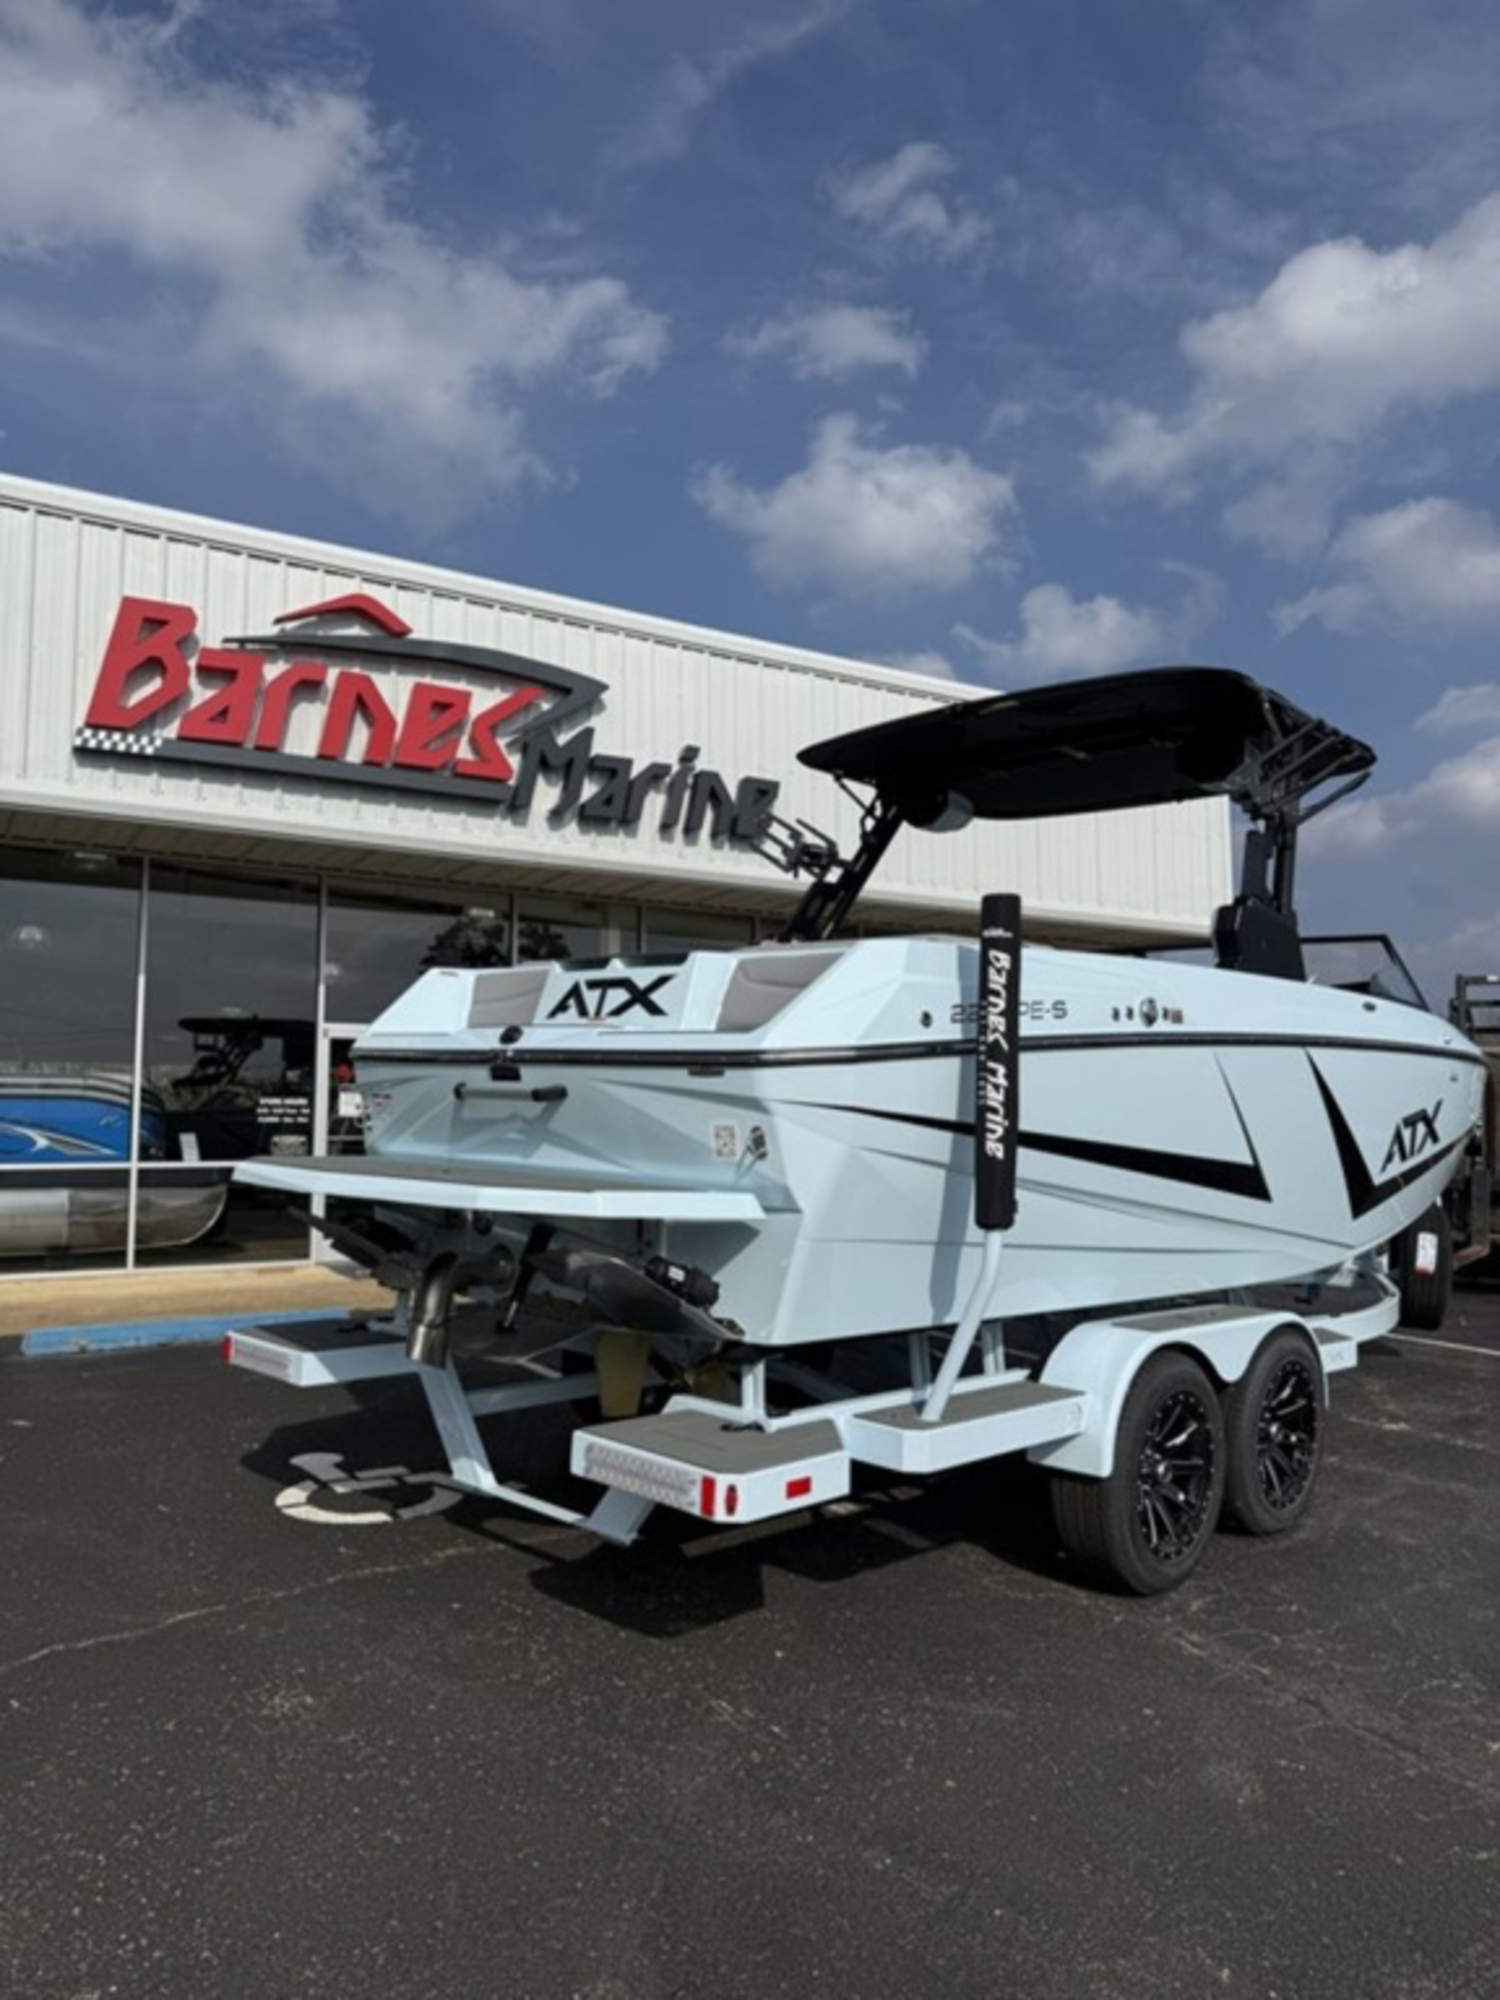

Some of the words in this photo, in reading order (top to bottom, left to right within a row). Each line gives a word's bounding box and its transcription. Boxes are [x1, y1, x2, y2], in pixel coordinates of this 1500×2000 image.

[84, 595, 549, 782] Barnes
[508, 726, 780, 842] Marine
[546, 973, 677, 1019] ATX
[987, 948, 1011, 1052] Barnes
[985, 1060, 1008, 1160] Marine
[1379, 1098, 1444, 1174] ATX
